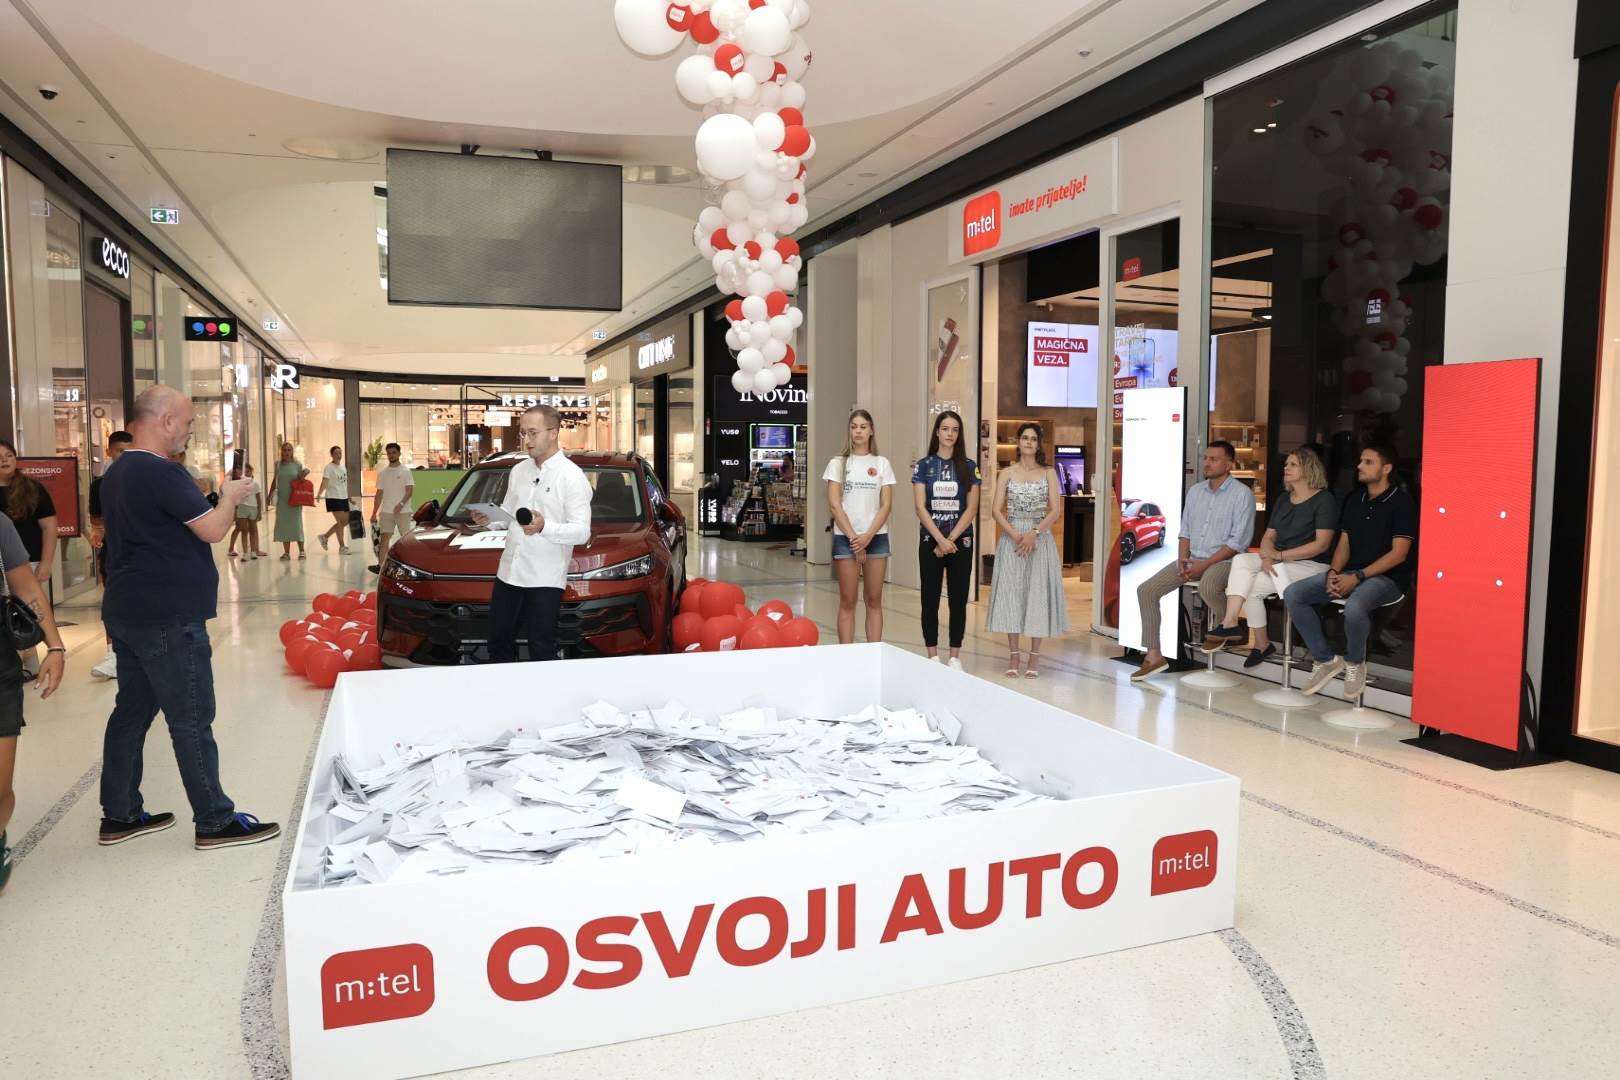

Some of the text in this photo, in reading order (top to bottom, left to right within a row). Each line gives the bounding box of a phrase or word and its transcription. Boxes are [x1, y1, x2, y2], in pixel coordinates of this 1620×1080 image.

[1009, 175, 1088, 218] imate prijatelje!
[967, 208, 995, 238] m:tel
[102, 236, 129, 279] ecco
[1037, 338, 1085, 350] MAGIČNA
[1037, 354, 1067, 365] VEZA.
[276, 364, 299, 389] R
[941, 470, 951, 480] 14
[1159, 845, 1209, 876] m:tel
[487, 846, 1119, 1002] OSVOJI AUTO
[335, 964, 421, 1003] m:tel
